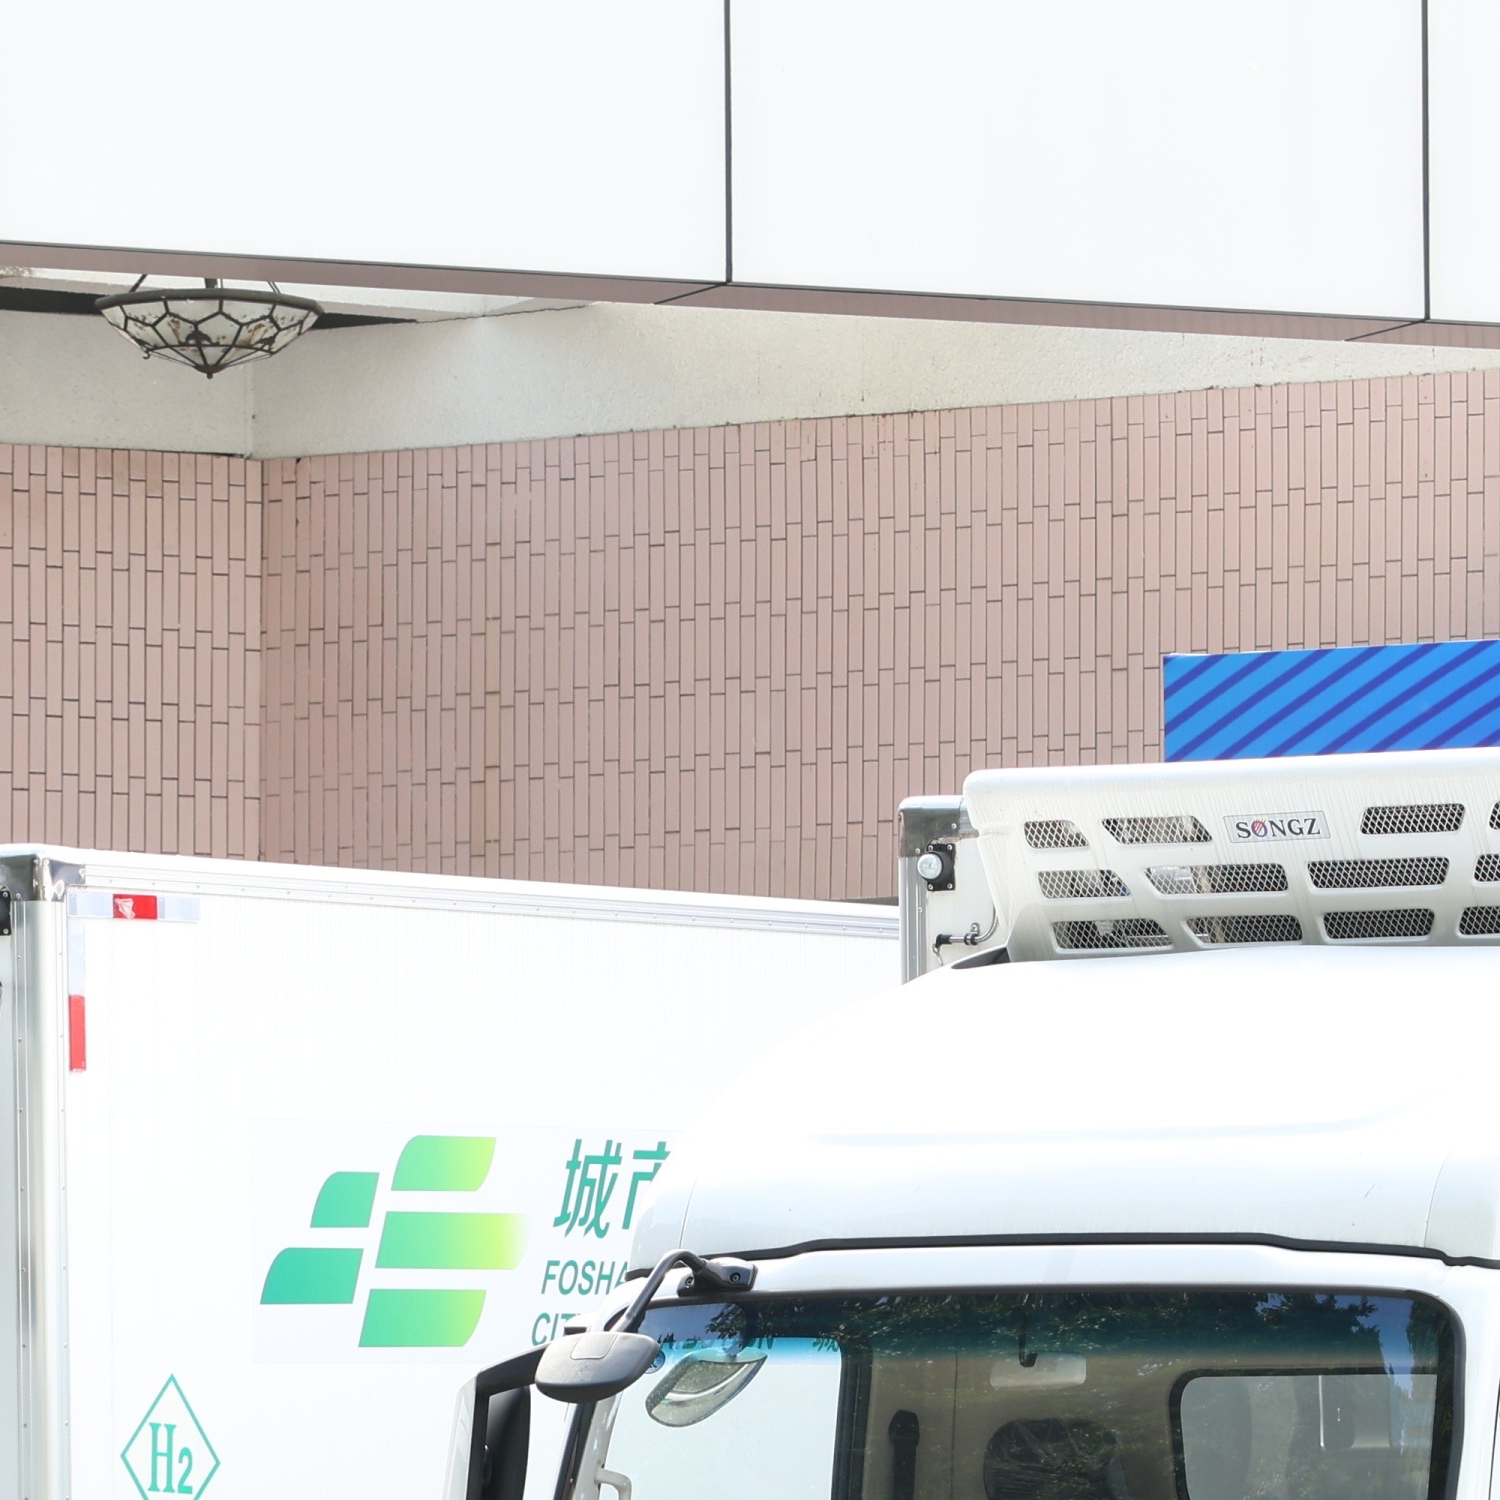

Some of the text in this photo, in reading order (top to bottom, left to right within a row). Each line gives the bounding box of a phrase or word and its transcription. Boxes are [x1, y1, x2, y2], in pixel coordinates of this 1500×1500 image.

[1234, 813, 1322, 841] SONGZ
[541, 1260, 629, 1296] FOSHA
[531, 1312, 581, 1346] CI
